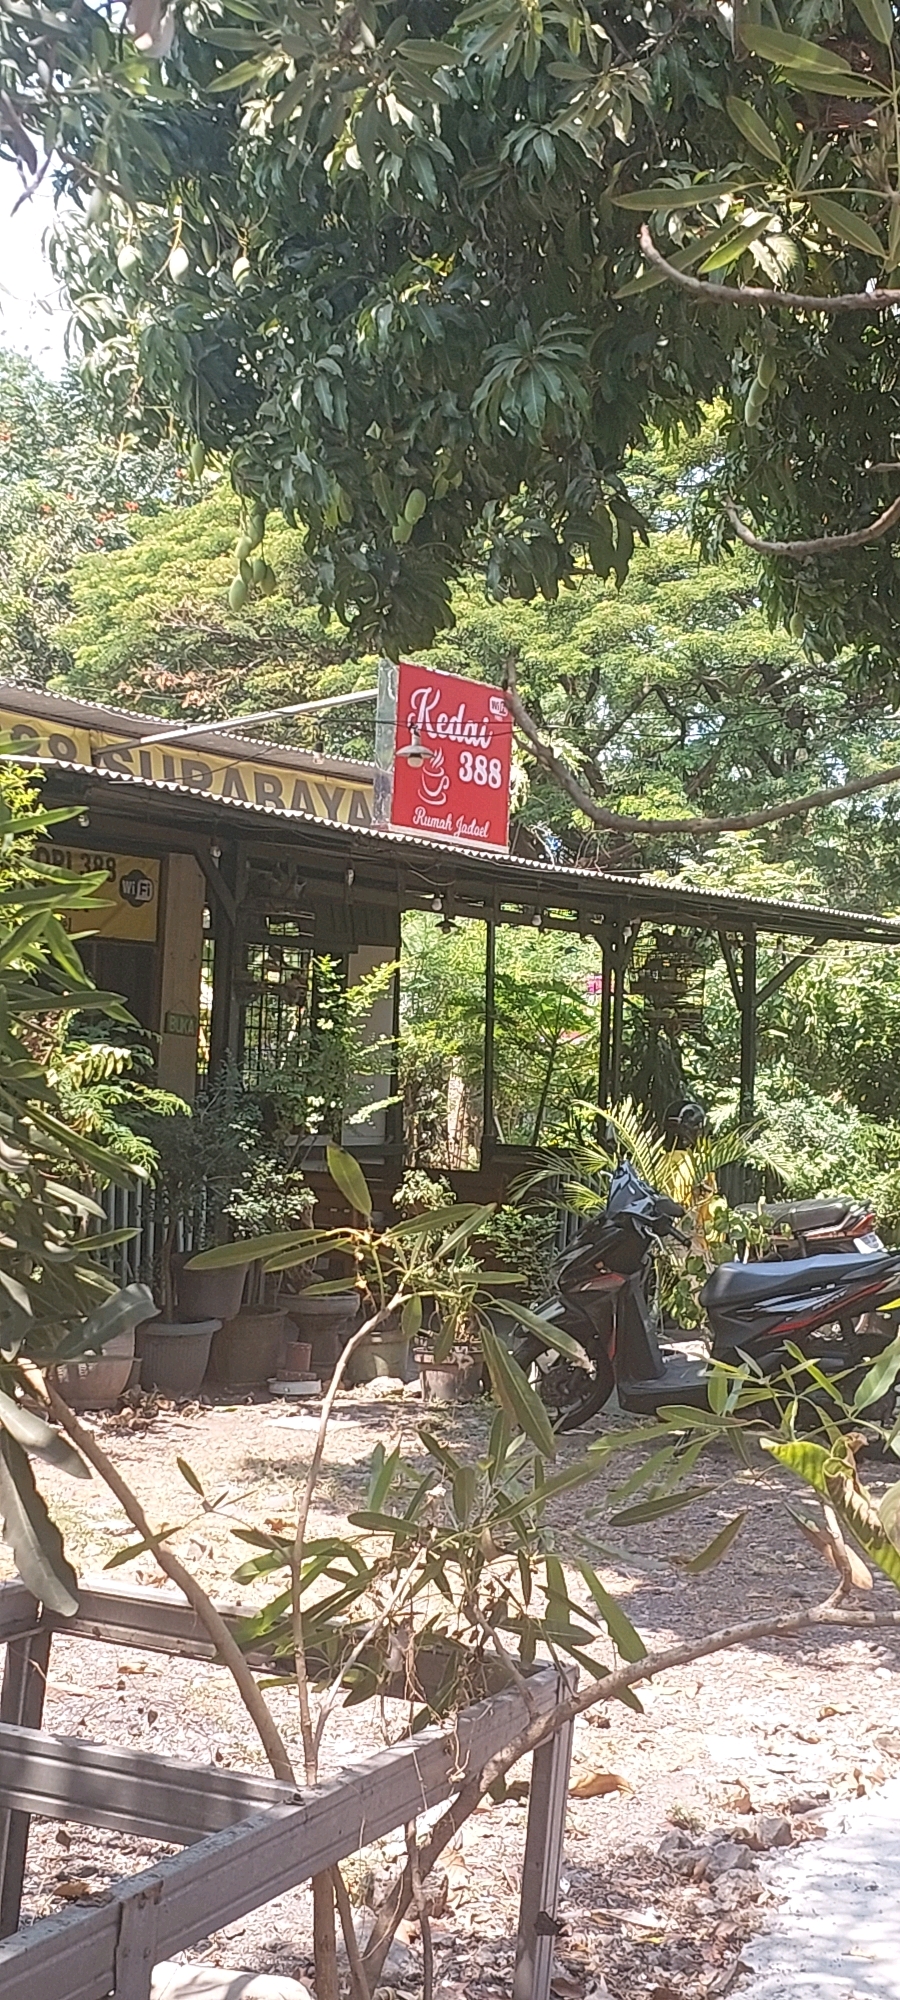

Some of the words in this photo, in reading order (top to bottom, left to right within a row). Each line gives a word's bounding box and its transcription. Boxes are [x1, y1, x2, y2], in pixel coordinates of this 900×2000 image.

[408, 687, 493, 748] Kedai
[459, 751, 502, 789] 388
[102, 748, 374, 828] SURABAYA
[412, 806, 453, 831] Rumah
[453, 815, 491, 838] Jadoel
[32, 846, 72, 871] OPI
[169, 1015, 195, 1035] BUKA
